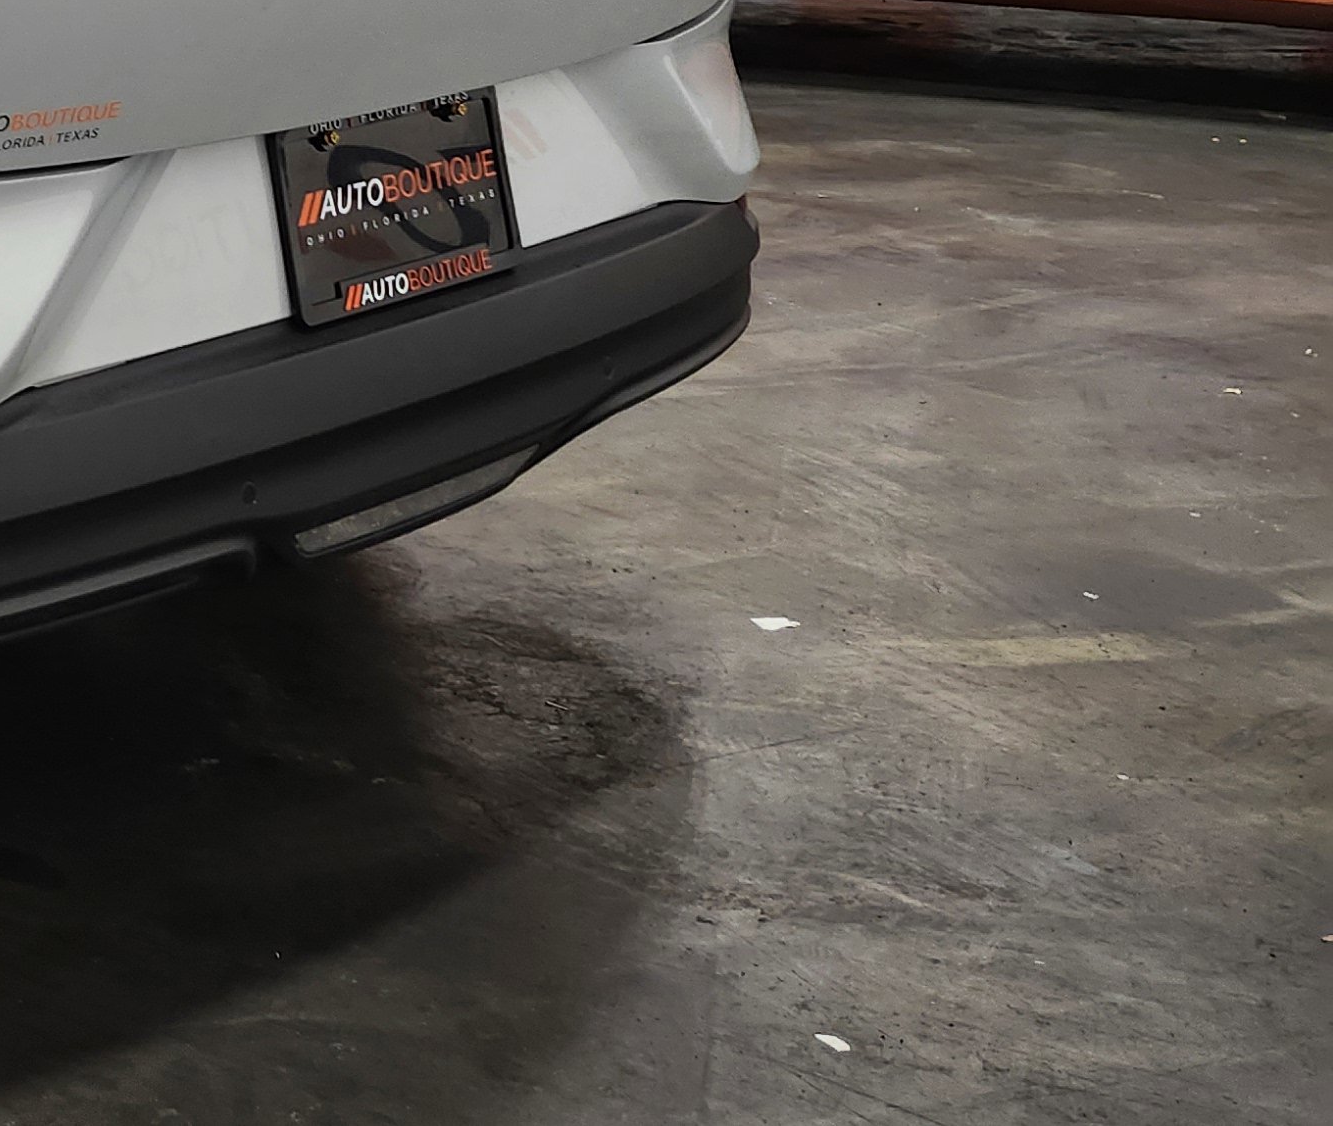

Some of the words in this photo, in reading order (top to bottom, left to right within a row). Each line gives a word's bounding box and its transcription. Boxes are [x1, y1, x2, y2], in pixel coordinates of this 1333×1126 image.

[56, 127, 100, 144] TEXAS
[306, 228, 345, 247] OHIO
[362, 206, 430, 231] FLORIDA
[448, 188, 496, 208] TEXAS
